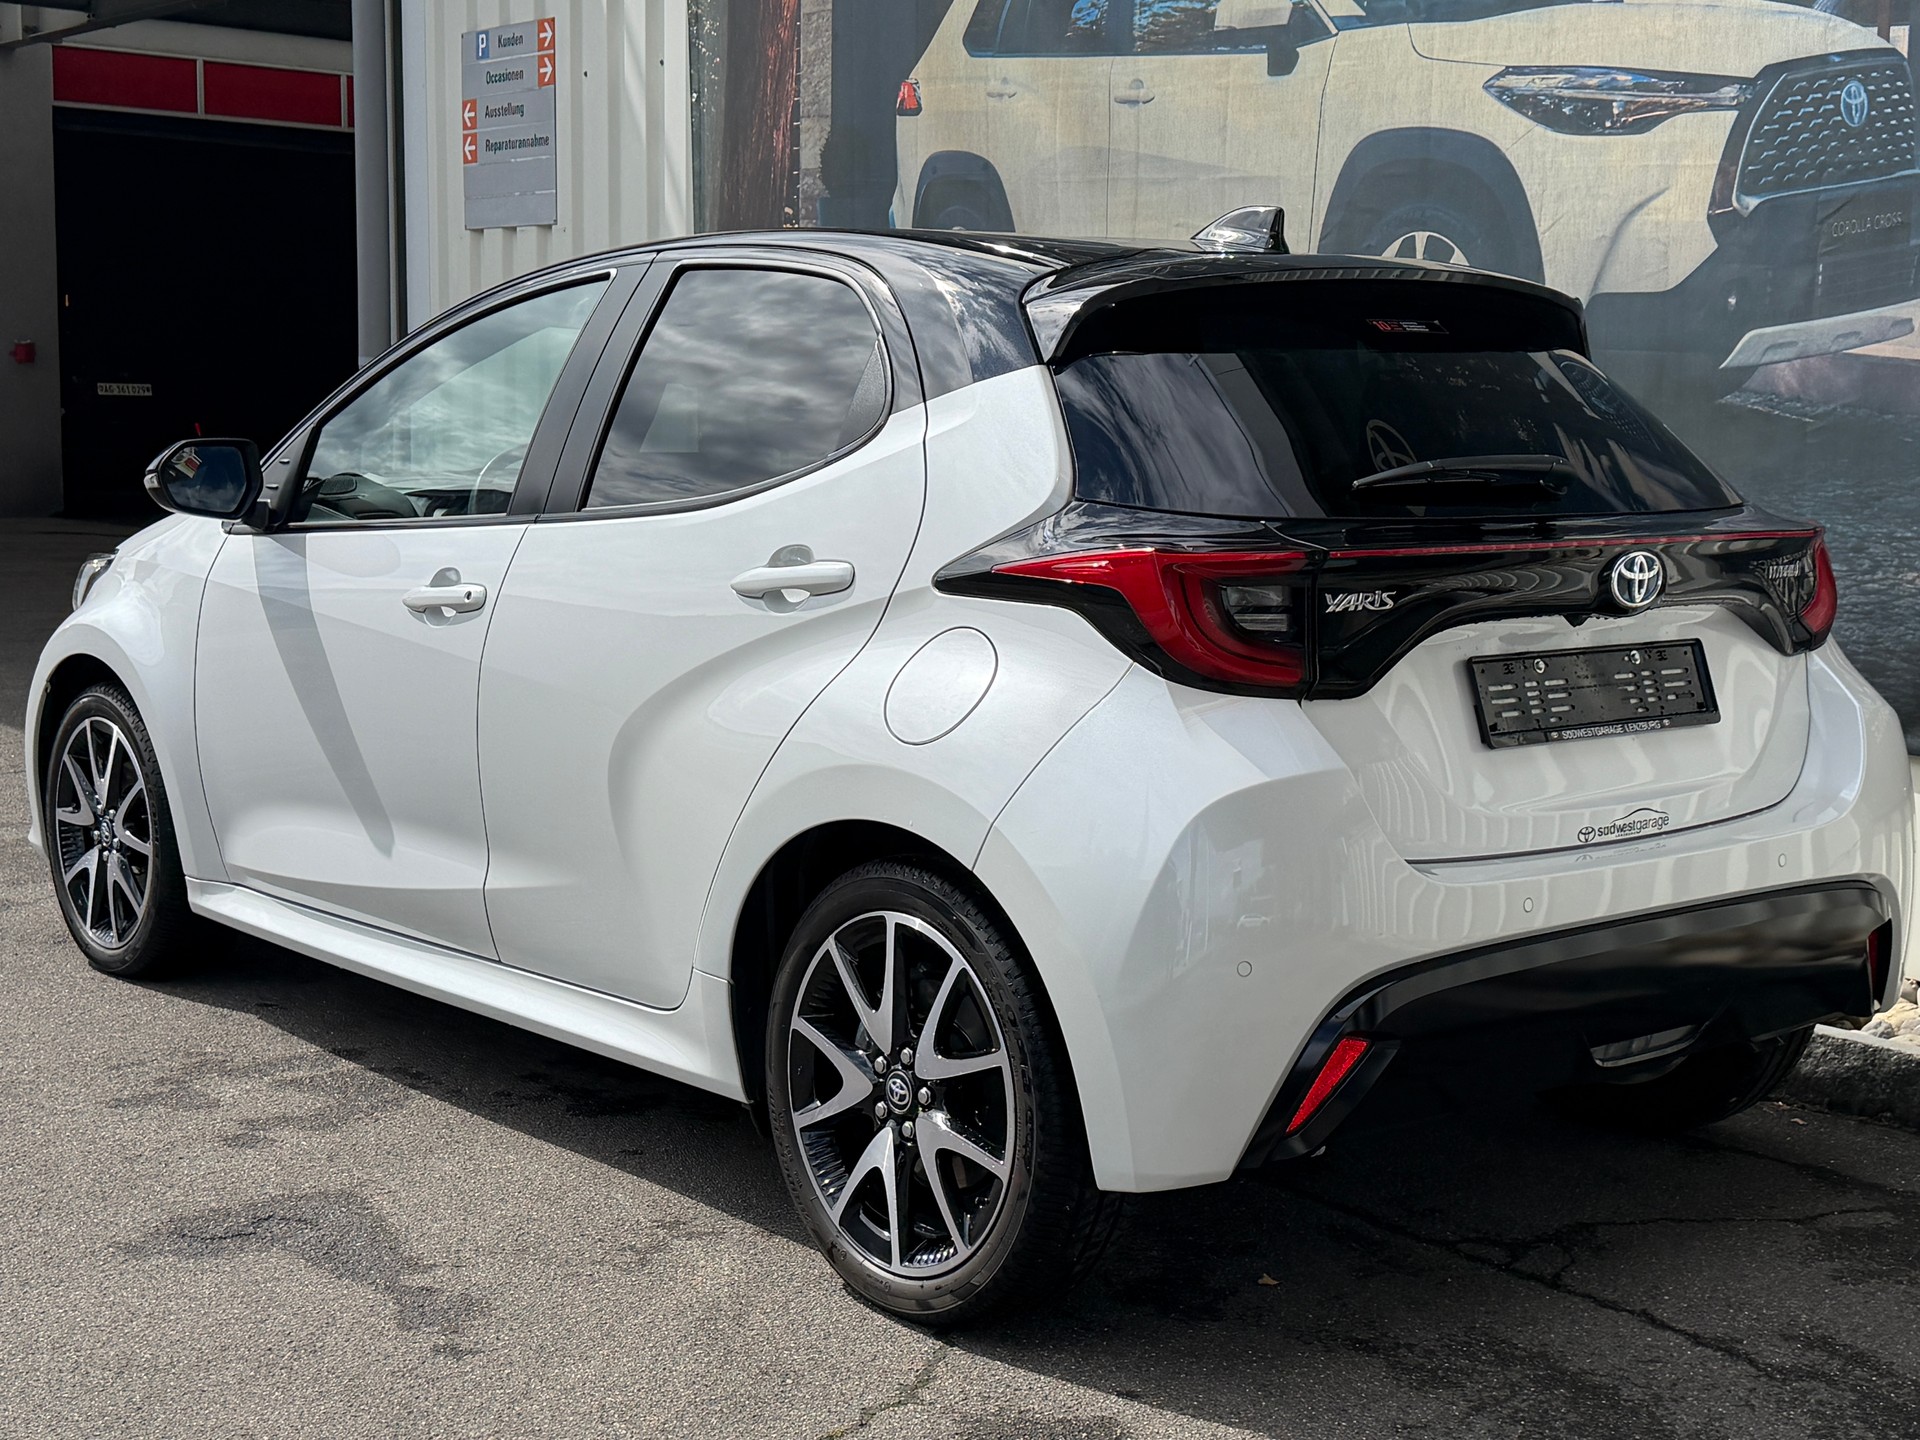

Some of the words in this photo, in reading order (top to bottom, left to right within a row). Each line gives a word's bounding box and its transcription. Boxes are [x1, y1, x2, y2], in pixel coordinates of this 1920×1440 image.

[478, 33, 487, 57] P
[497, 33, 524, 48] Kunden
[486, 68, 524, 85] Occasionen
[485, 103, 525, 119] Ausstellung
[485, 133, 550, 154] Reparaturannahme
[1832, 217, 1872, 237] COROLLA
[1874, 212, 1902, 230] CROSS
[1325, 590, 1397, 613] YARIS
[1625, 720, 1661, 732] LENZBURG
